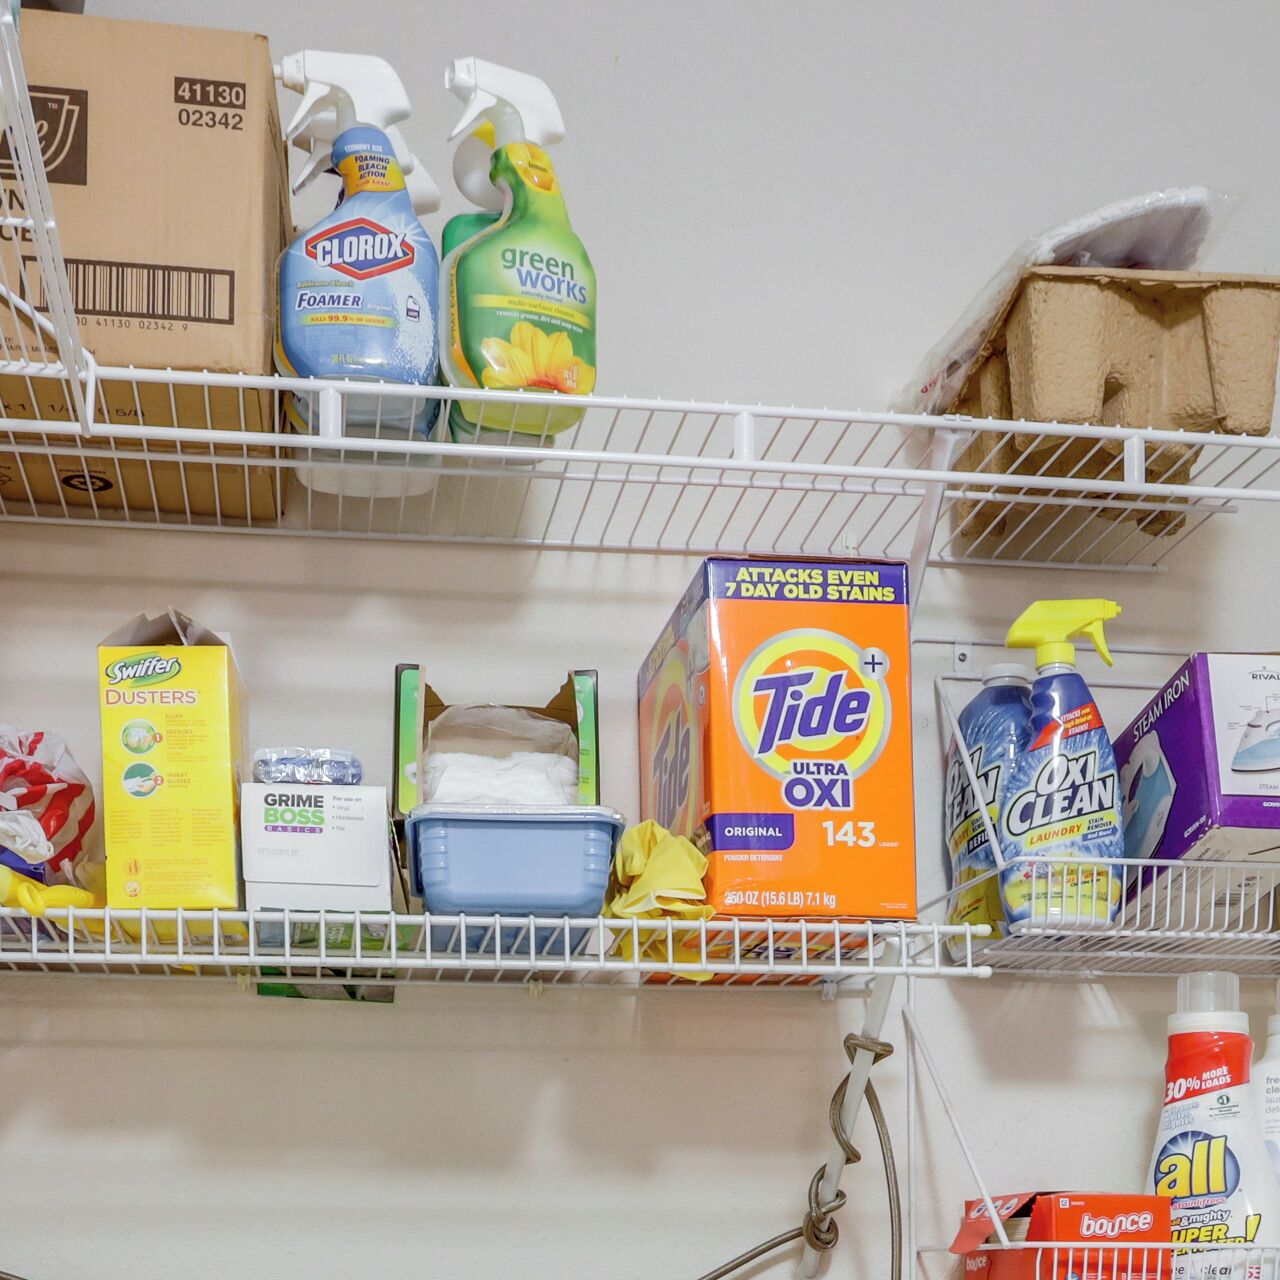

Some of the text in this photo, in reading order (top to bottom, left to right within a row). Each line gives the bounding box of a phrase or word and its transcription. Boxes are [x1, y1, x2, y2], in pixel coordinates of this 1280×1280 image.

[177, 82, 245, 105] 41130
[177, 108, 244, 131] 02342
[354, 155, 390, 165] FOAMING
[357, 163, 388, 172] BLEACH
[359, 171, 386, 180] ACTION
[316, 232, 407, 268] CLOROX
[501, 248, 574, 281] green
[516, 267, 587, 305] works
[296, 291, 362, 310] FOAMER
[96, 317, 189, 332] 41130 02342 9
[736, 567, 879, 586] ATTACKS EVEN
[725, 582, 896, 602] 7 DAY OLD STAINS
[108, 655, 178, 685] Swiffer
[105, 688, 197, 705] DUSTERS
[1133, 670, 1191, 742] STEAM IRON
[752, 671, 872, 756] Tide
[793, 762, 848, 776] ULTRA
[1035, 751, 1097, 796] OXI
[784, 777, 851, 808] OXI
[1258, 783, 1279, 791] STEAM
[263, 793, 324, 808] GRIME
[1007, 773, 1115, 837] CLEAN
[263, 807, 325, 826] BOSS
[1087, 820, 1113, 832] REMOVER
[1088, 816, 1104, 826] STAIN
[266, 825, 322, 834] BASICS
[724, 820, 876, 847] ORIGINAL 143
[1029, 823, 1083, 846] LAUNDRY
[744, 890, 837, 909] OZ (15.6 LB) 7.1 kg
[1201, 1074, 1232, 1090] LOADS
[1202, 1065, 1229, 1081] MORE
[1166, 1076, 1201, 1100] 30%
[1156, 1135, 1228, 1199] all
[1172, 1196, 1228, 1210] stainlifters
[1079, 1211, 1154, 1238] bounce
[966, 1255, 988, 1272] bounce
